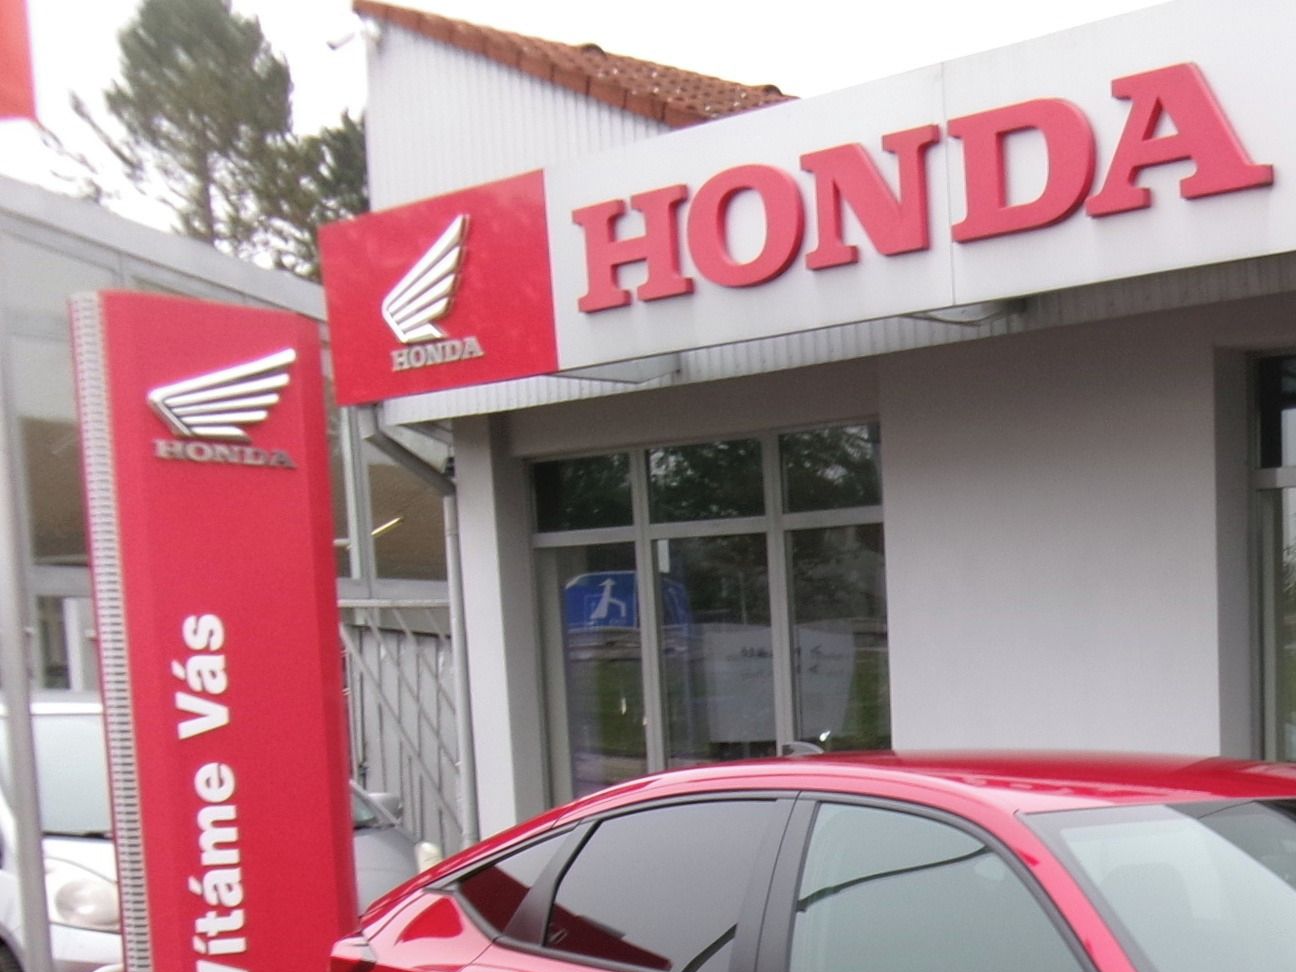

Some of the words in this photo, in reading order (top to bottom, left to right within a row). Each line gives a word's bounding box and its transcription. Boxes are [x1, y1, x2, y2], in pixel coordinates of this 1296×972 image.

[572, 62, 1275, 314] HONDA
[391, 336, 484, 372] HONDA
[153, 439, 299, 469] HONDA
[171, 613, 231, 740] Vás
